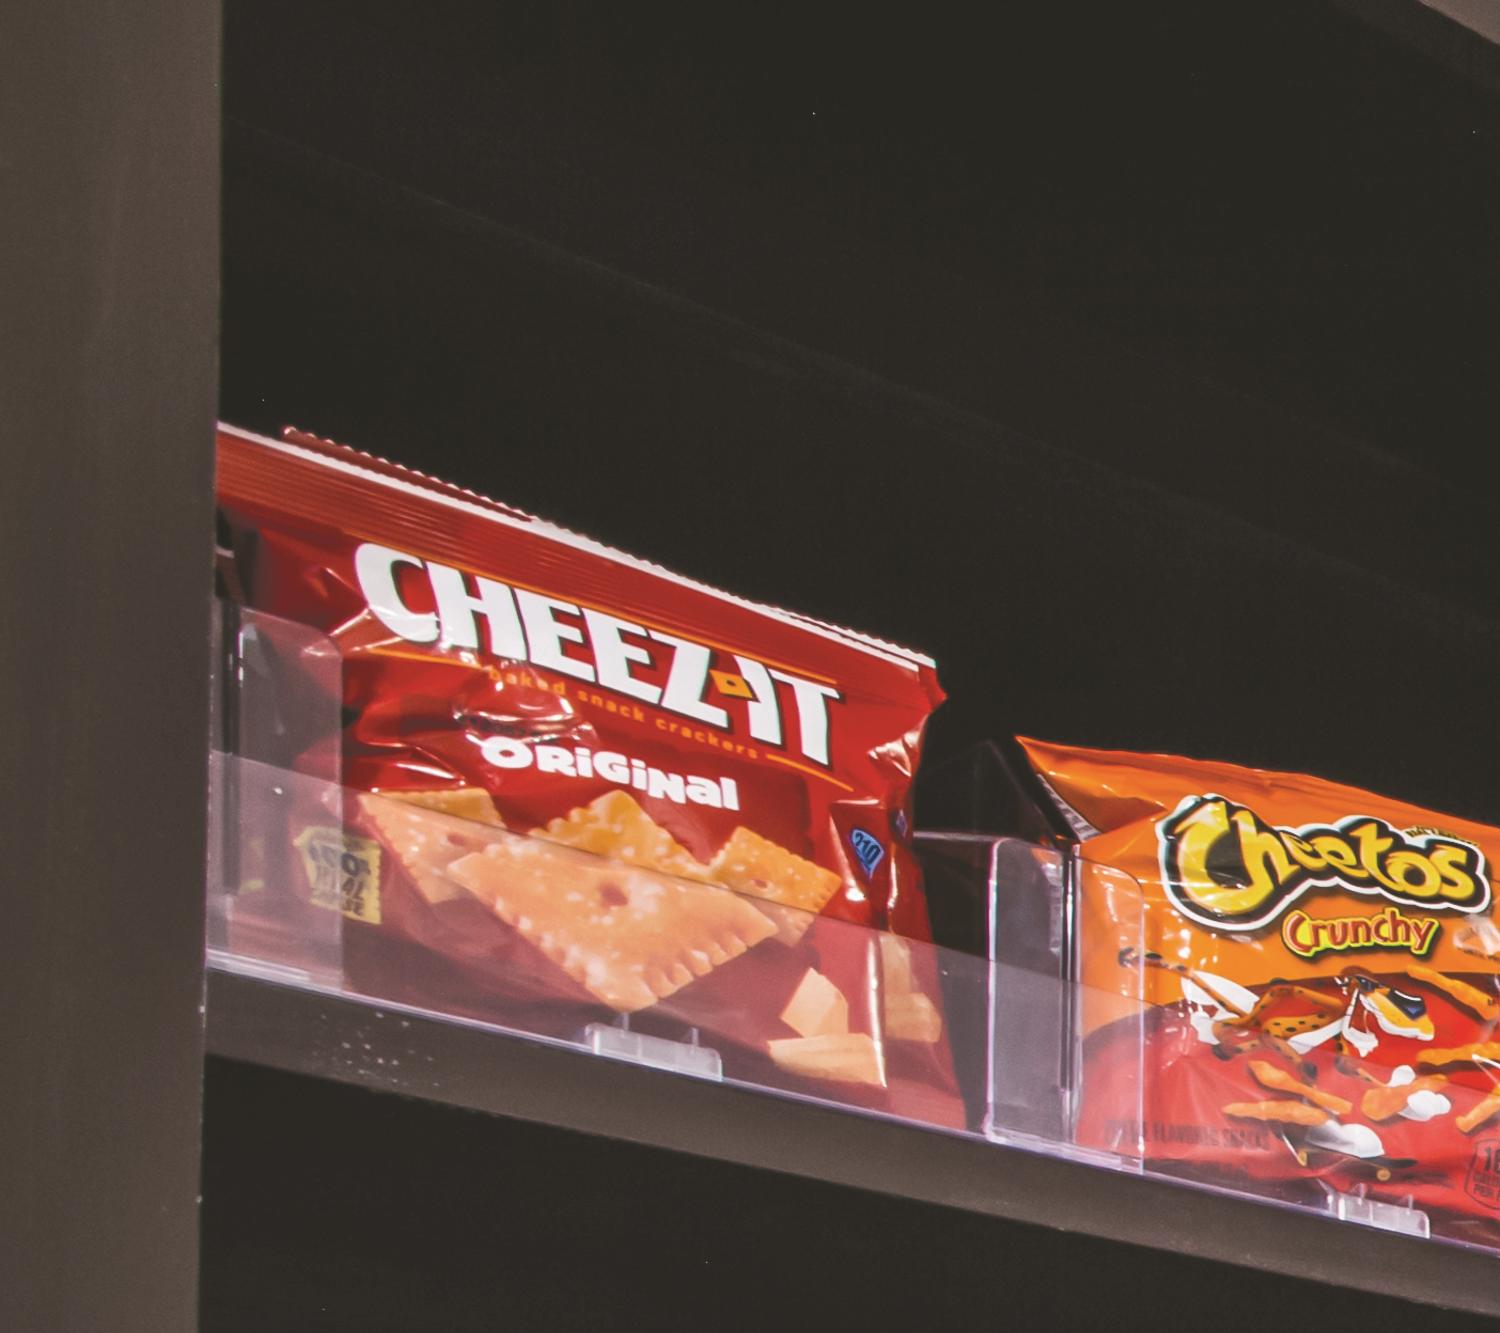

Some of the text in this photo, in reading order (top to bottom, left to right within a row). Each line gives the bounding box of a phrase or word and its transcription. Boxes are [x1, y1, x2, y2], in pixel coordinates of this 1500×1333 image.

[577, 688, 645, 723] snack
[655, 715, 759, 761] crackers
[1172, 800, 1475, 917] Cheetos
[1284, 909, 1440, 956] Crunchy
